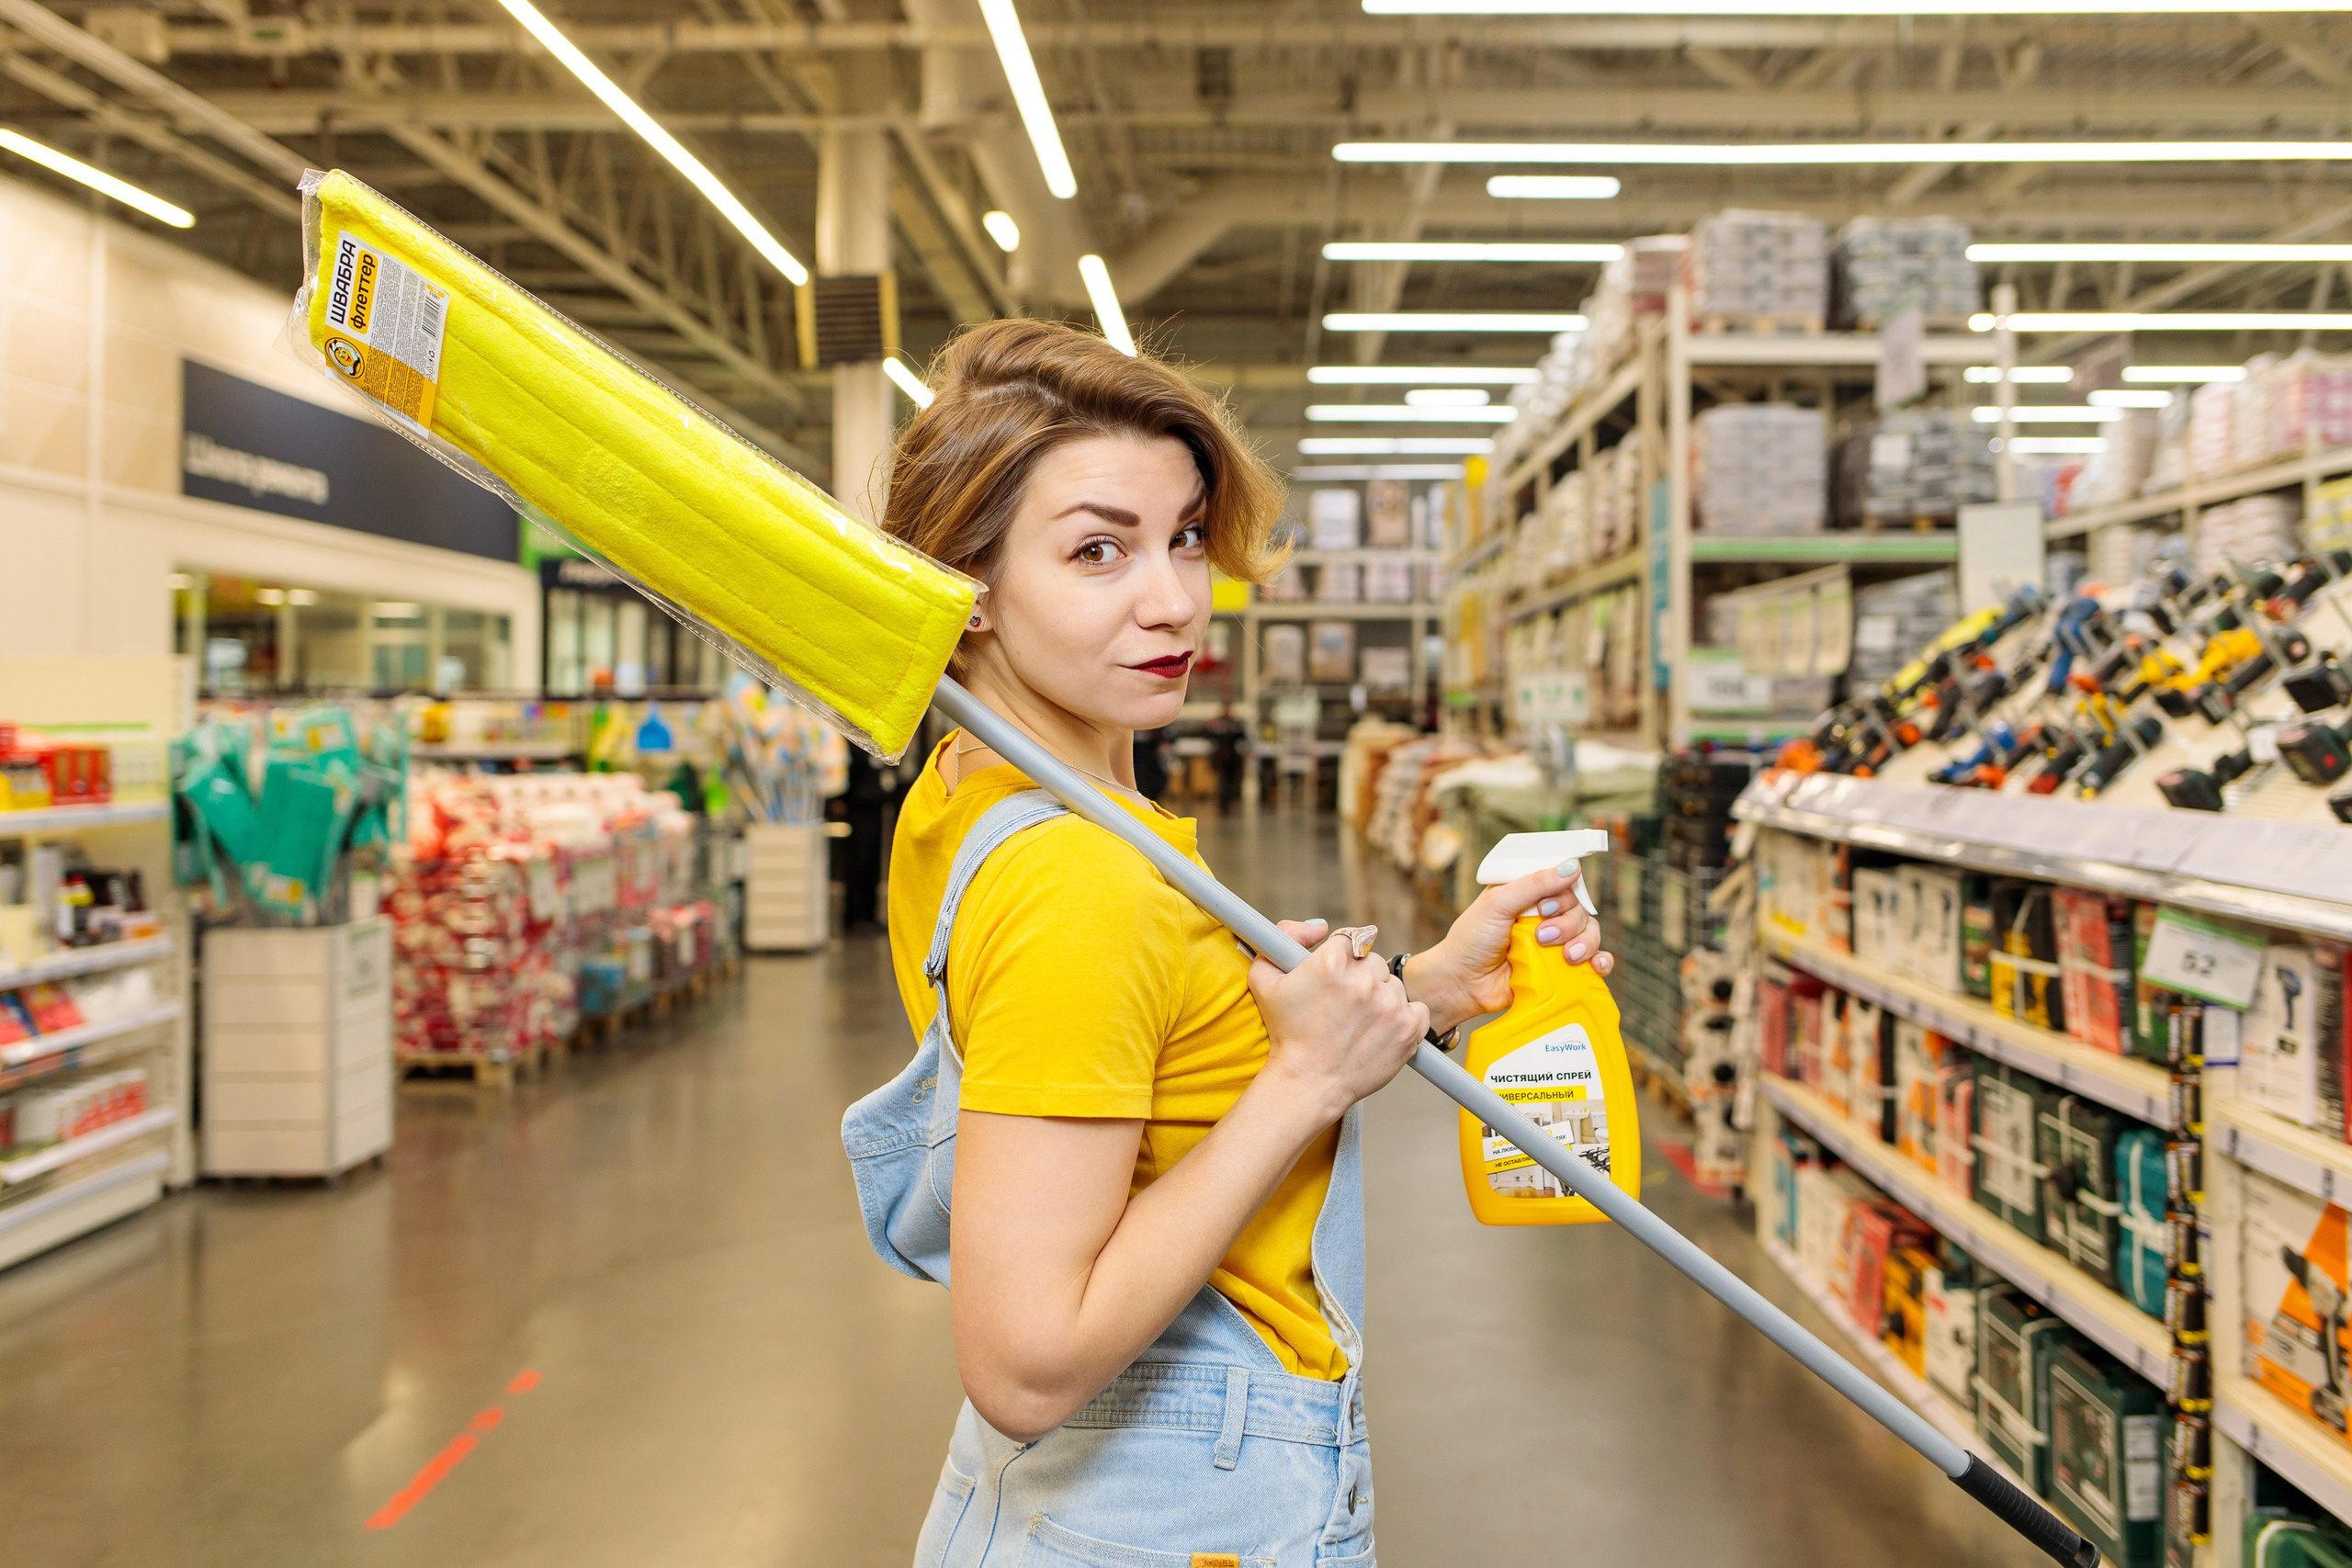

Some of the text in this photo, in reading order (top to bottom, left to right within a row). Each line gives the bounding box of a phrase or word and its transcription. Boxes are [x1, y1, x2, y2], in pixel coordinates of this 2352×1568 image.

[331, 240, 356, 324] ШВАБРА
[350, 254, 376, 329] флеттер
[1545, 1043, 1587, 1053] EasyWork
[1490, 1070, 1591, 1083] ЧИСТЯЩИЙ СПРЕЙ
[1499, 1089, 1574, 1101] ИВЕРСАЛЬНЫЙ
[1503, 1156, 1532, 1166] ОСТАВЛЯЕ
